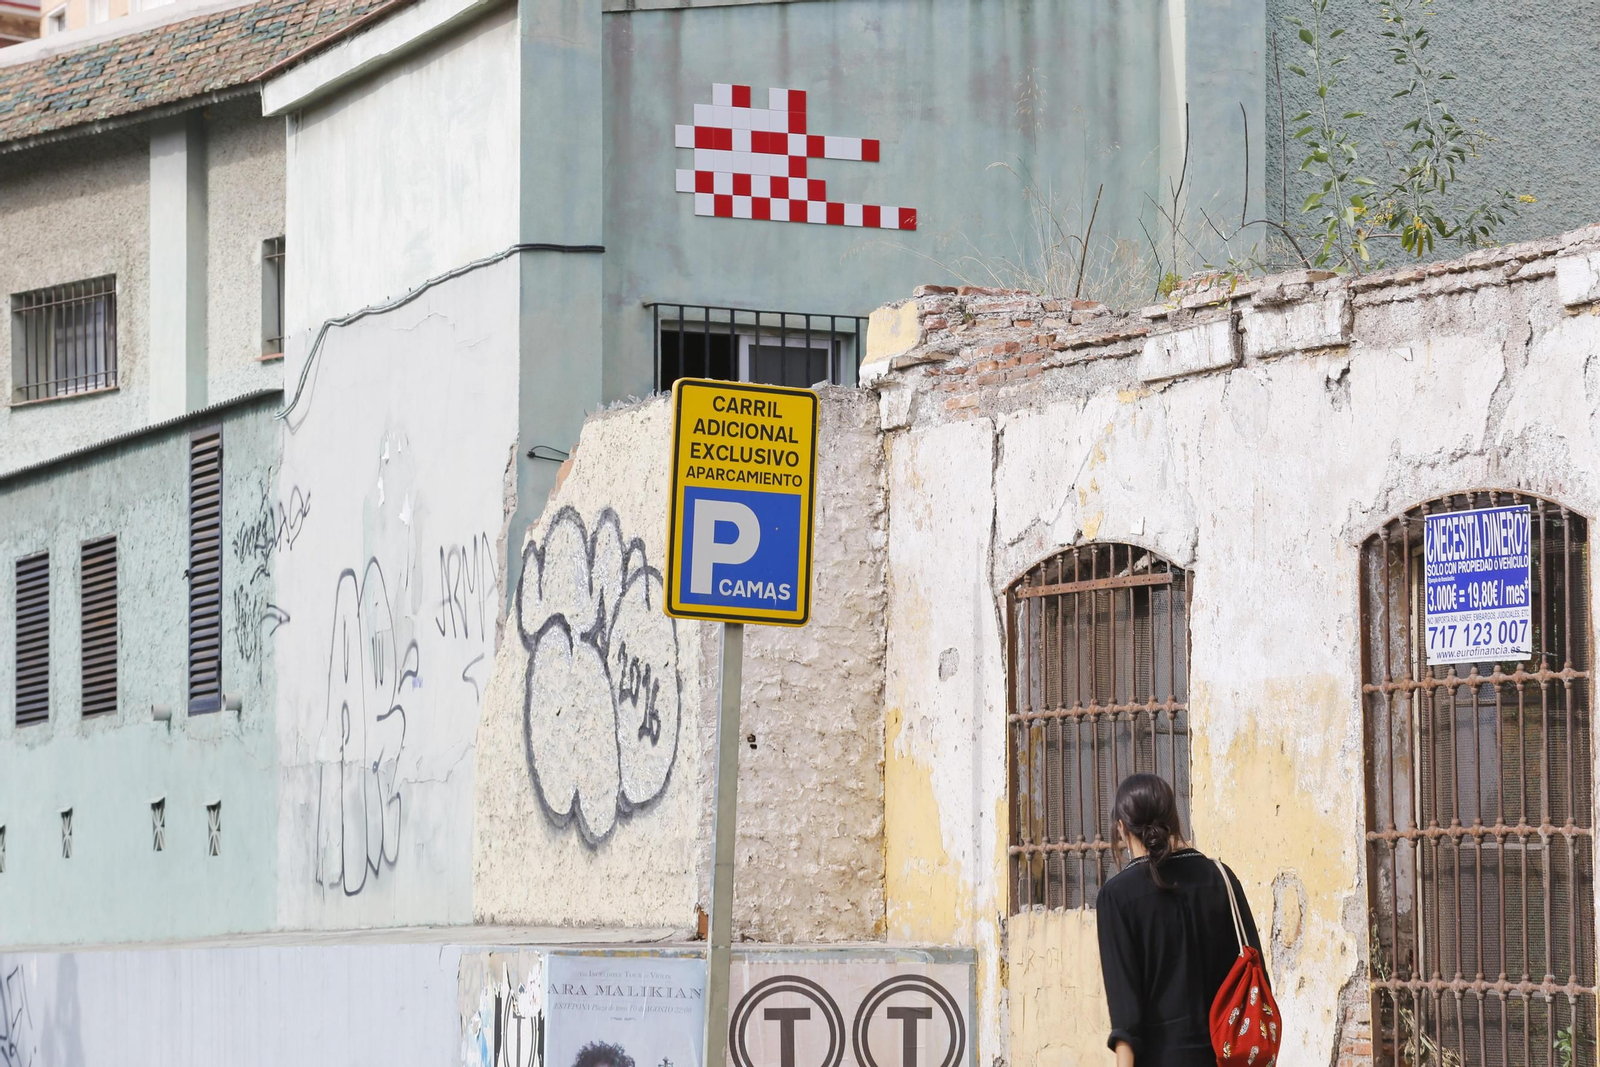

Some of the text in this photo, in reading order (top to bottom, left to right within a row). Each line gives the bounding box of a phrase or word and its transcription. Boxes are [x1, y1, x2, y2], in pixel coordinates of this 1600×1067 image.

[713, 396, 782, 418] CARRIL
[693, 418, 798, 443] ADICIONAL
[690, 442, 799, 467] EXCLUSIVO
[686, 466, 803, 487] APARCAMIENTO
[690, 499, 761, 594] P
[1427, 509, 1529, 563] ¿NECESITA DINERO?
[1427, 561, 1443, 576] SÓLO
[1445, 562, 1457, 575] CON
[1458, 558, 1493, 574] PROPIEDAD
[1499, 554, 1529, 570] VEHÍCULO
[719, 578, 791, 600] CAMAS
[1428, 584, 1457, 611] 3.000€
[1468, 580, 1498, 610] 19,80€
[1428, 619, 1528, 649] 717 123 007
[1436, 645, 1520, 659] www.eurofinancia.es
[547, 983, 702, 1000] ARA MALIKIAN
[554, 1002, 590, 1011] ESTEPONA
